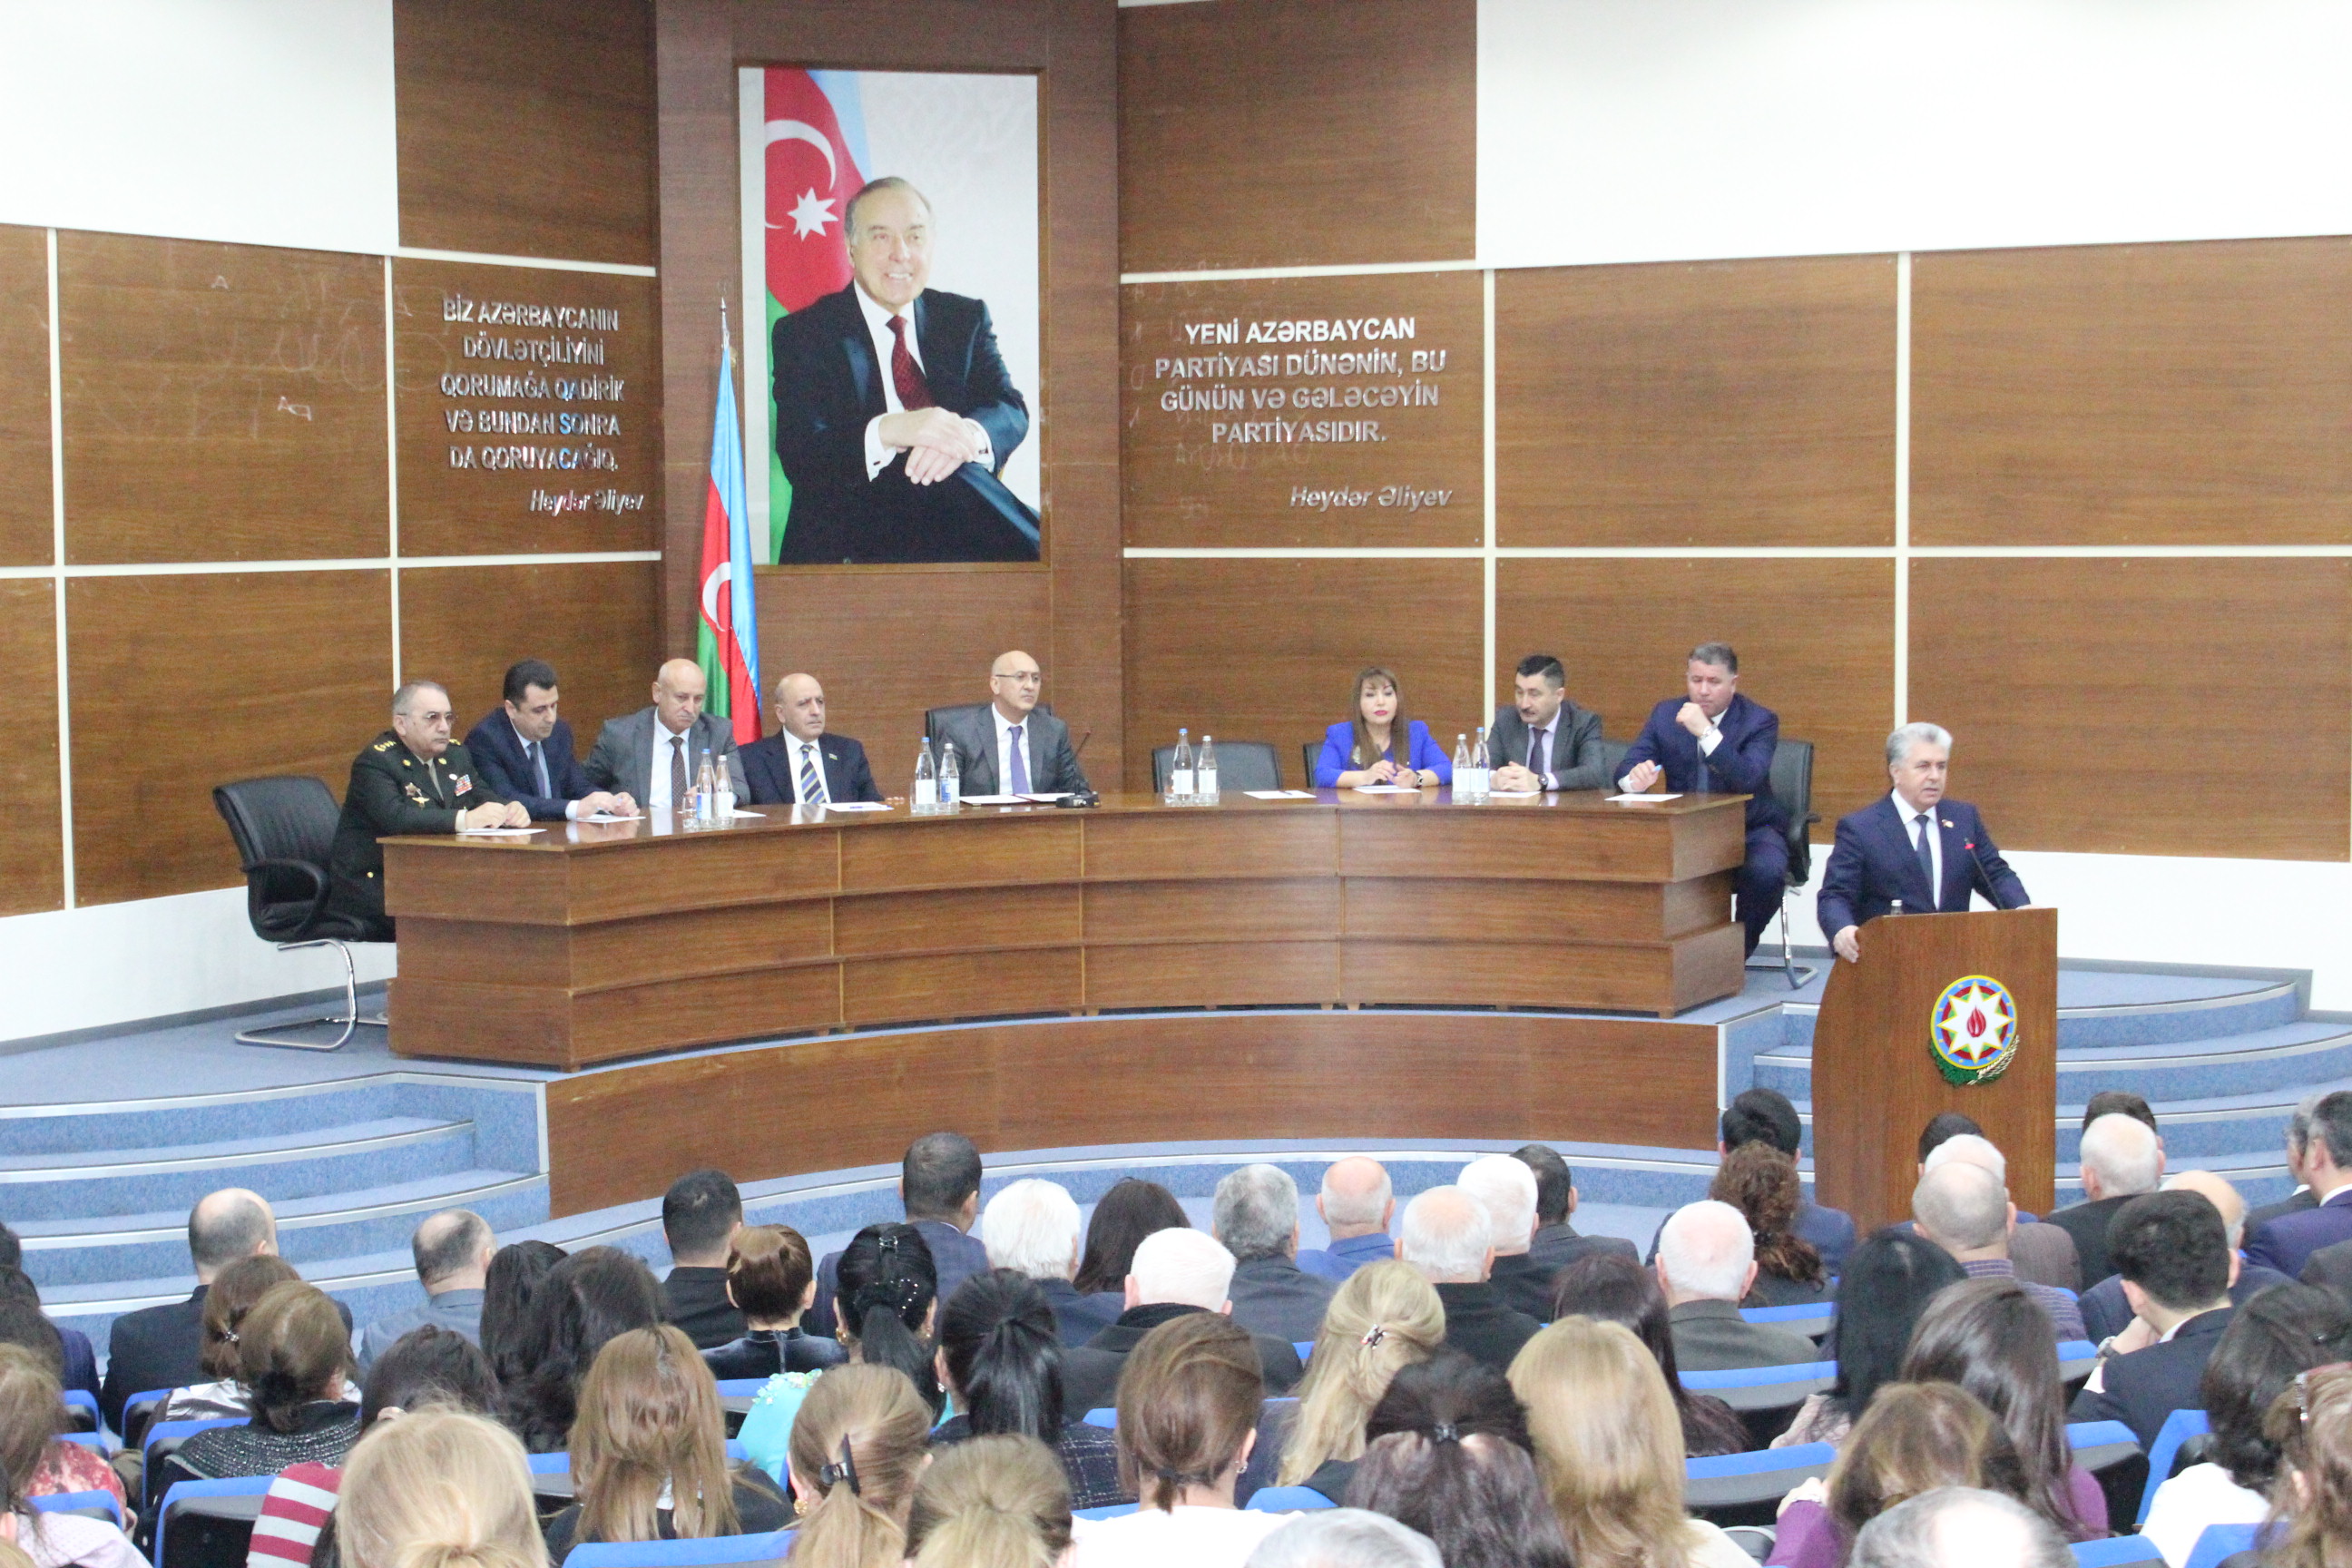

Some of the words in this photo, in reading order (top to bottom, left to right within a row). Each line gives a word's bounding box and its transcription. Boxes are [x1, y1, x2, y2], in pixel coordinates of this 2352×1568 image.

[443, 294, 474, 323] BİZ
[477, 300, 619, 331] AZƏRBAYCANIN
[1185, 318, 1239, 345] YENİ
[1245, 317, 1416, 343] AZƏRBAYCAN
[463, 331, 604, 368] DÖVLƏTÇİLİYİNİ
[1155, 352, 1279, 378] PARTİYASI
[1286, 348, 1404, 378] DÜNƏNİN,
[1412, 349, 1446, 373] BU
[440, 370, 550, 399] QORUMAĞA
[554, 374, 624, 402] QADİRİK
[1161, 384, 1245, 412] GÜNÜN
[1251, 387, 1286, 409] VƏ
[1292, 378, 1439, 409] GƏLƏCƏYİN
[445, 409, 474, 433] VƏ
[478, 410, 554, 435] BUNDAN
[560, 412, 621, 436] SONRA
[1212, 416, 1388, 443] PARTİYASIDIR.
[449, 446, 476, 469] DA
[481, 442, 619, 471] QORUYACAĞIQ.
[530, 489, 591, 516] Heydər
[594, 488, 644, 515] Əliyev
[1290, 485, 1374, 513] Heydər
[1378, 485, 1453, 513] Əliyev
